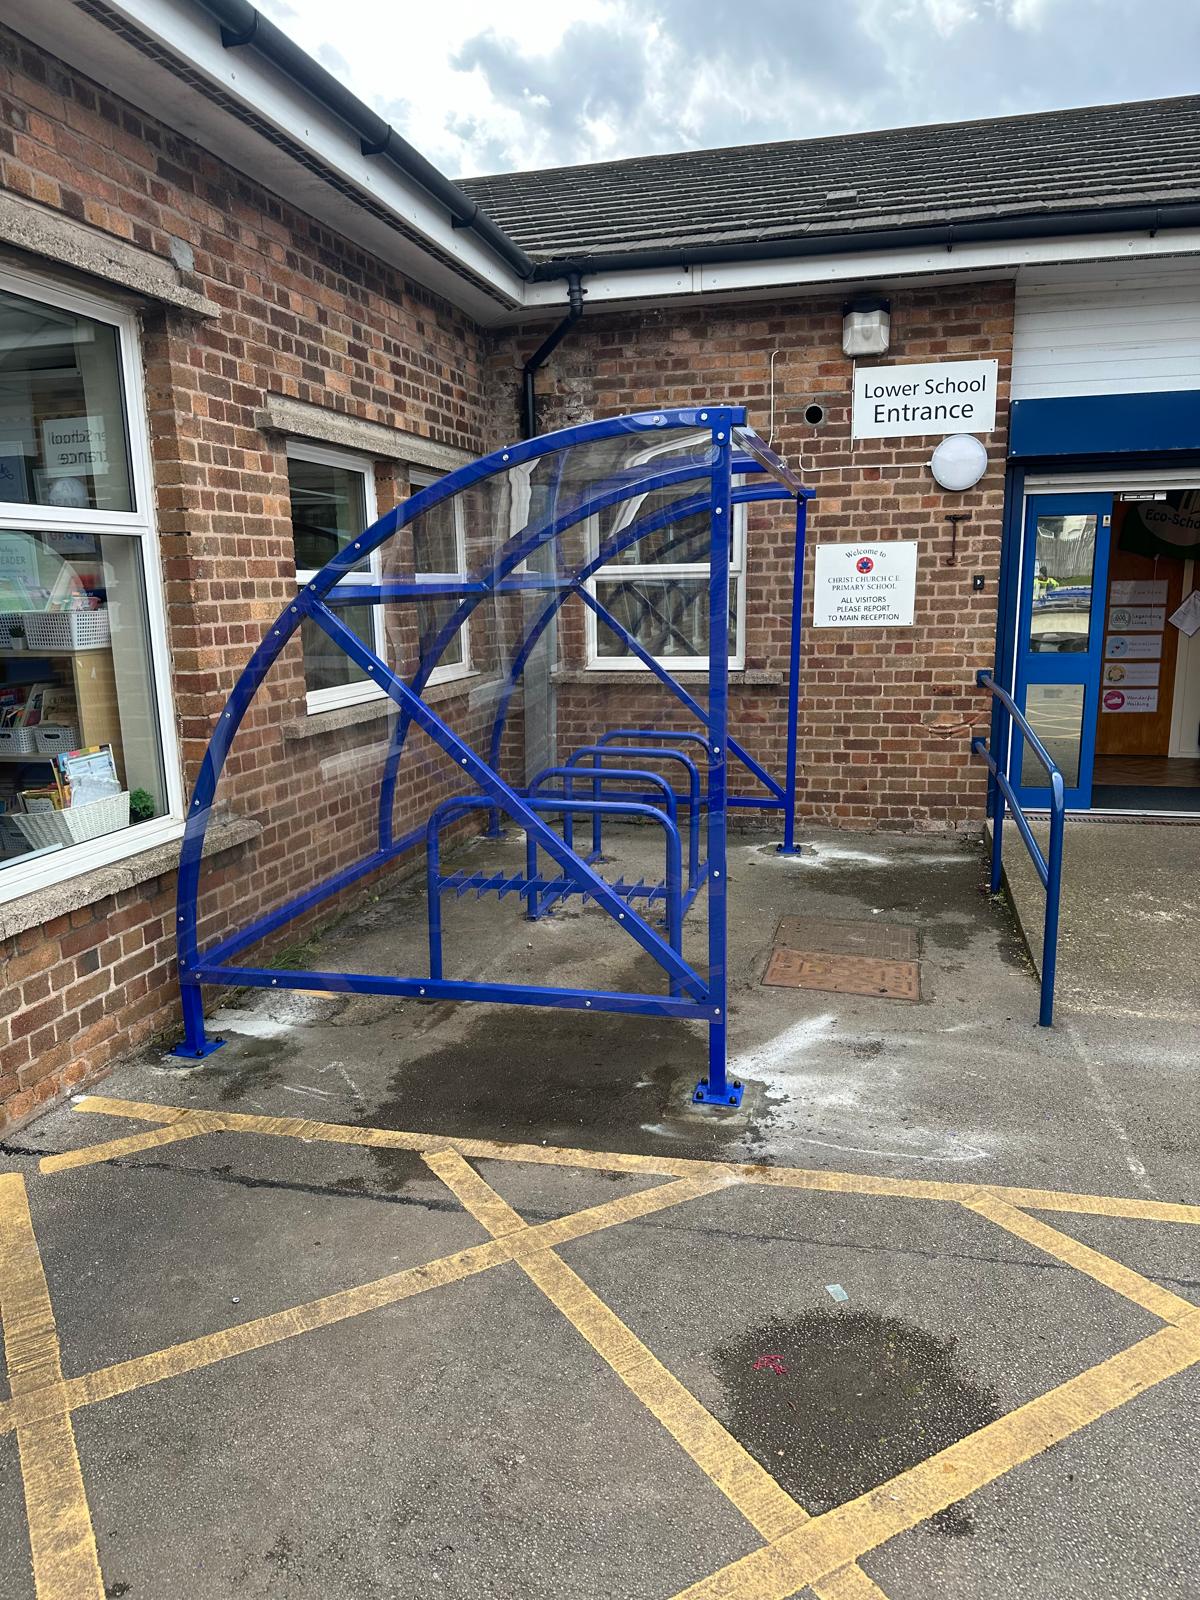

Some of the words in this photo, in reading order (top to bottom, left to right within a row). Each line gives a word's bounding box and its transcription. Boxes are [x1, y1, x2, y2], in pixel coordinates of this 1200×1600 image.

[865, 383, 920, 399] Lower
[925, 375, 986, 395] School
[874, 403, 974, 424] Entrance
[845, 548, 879, 559] Welcome
[855, 575, 887, 583] CHURCH
